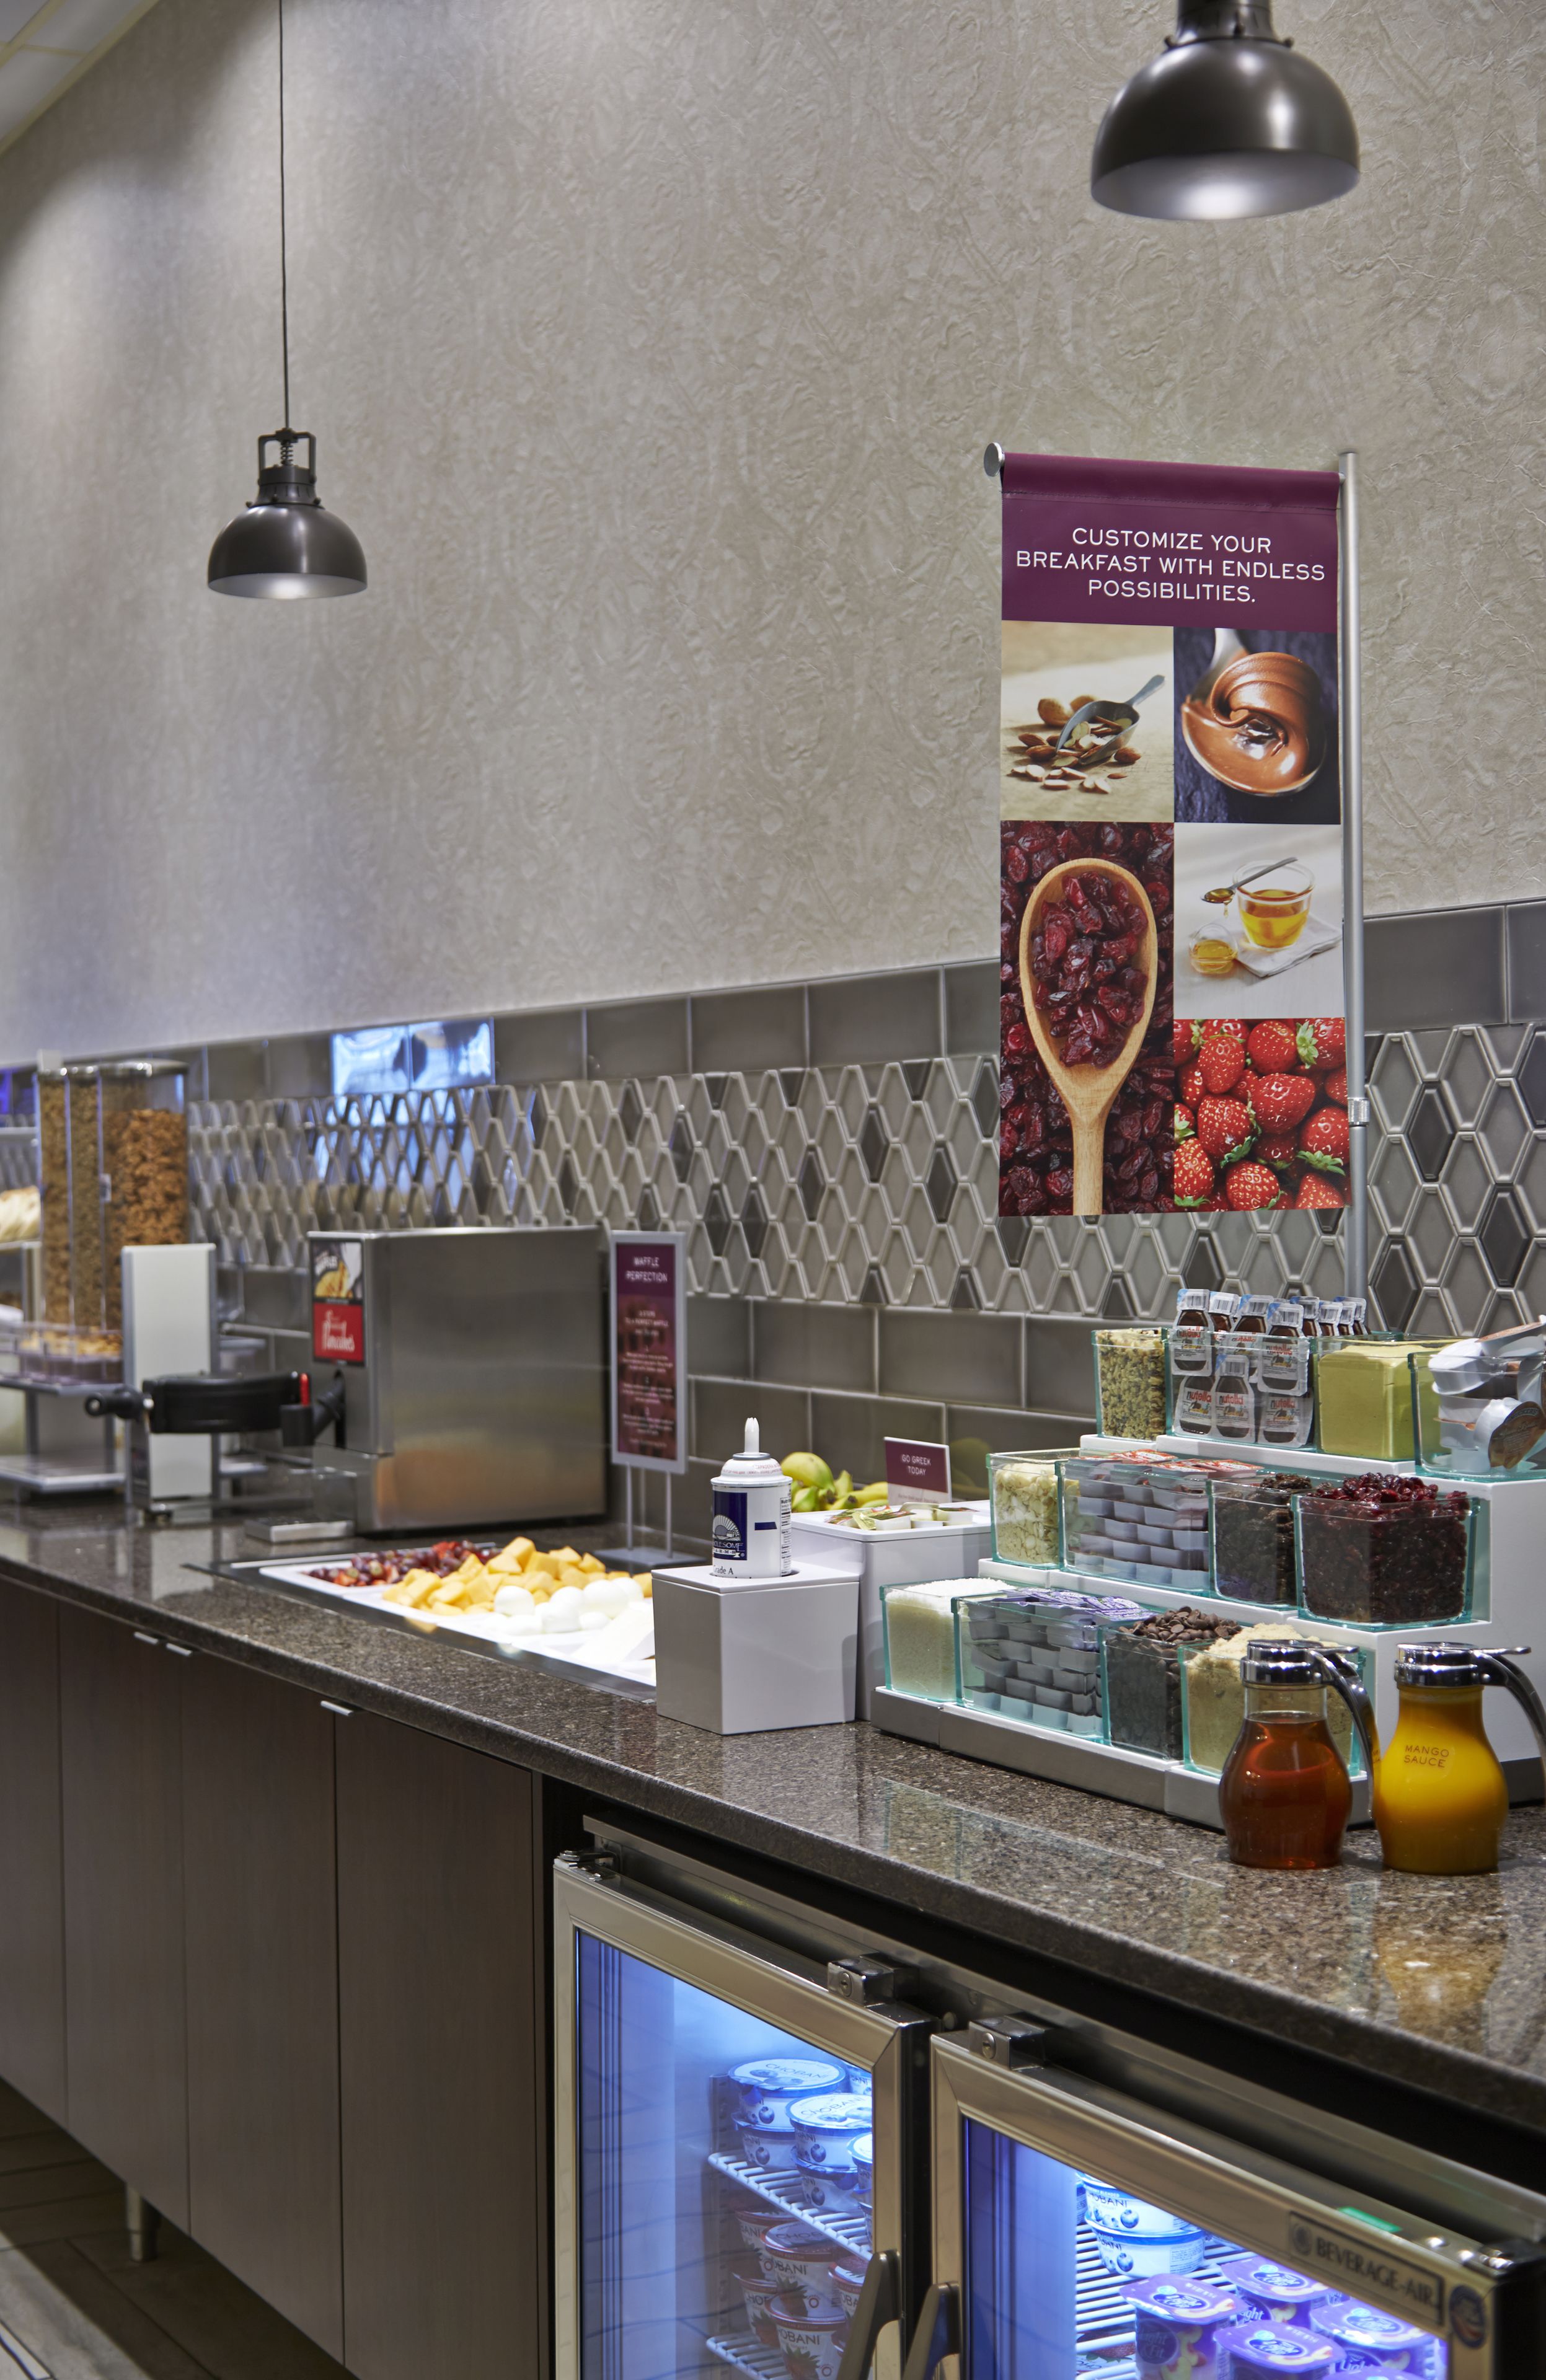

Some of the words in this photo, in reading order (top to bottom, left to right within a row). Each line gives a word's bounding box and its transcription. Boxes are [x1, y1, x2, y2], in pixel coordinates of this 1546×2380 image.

[1072, 527, 1203, 550] CUSTOMIZE
[1211, 535, 1271, 553] YOUR
[1016, 550, 1152, 573] BREAKFAST
[1159, 557, 1213, 575] WITH
[1222, 560, 1325, 581] ENDLESS
[1089, 580, 1256, 602] POSSIBILITIES.
[634, 1256, 660, 1267] WAFFLE
[625, 1270, 668, 1283] PERFECTION
[1186, 1390, 1212, 1404] nutella
[1219, 1393, 1244, 1406] nutella
[1271, 1398, 1296, 1409] nutella
[901, 1454, 911, 1463] GO
[911, 1455, 931, 1466] GREEK
[908, 1465, 926, 1475] TODAY
[728, 1567, 734, 1575] A
[1405, 1745, 1450, 1758] MANGO
[1403, 1755, 1447, 1768] SAUCE
[766, 2063, 828, 2079] CHOBANI
[800, 2097, 865, 2116] CHOBANI
[1316, 2236, 1433, 2303] BEVERAGE-AIR
